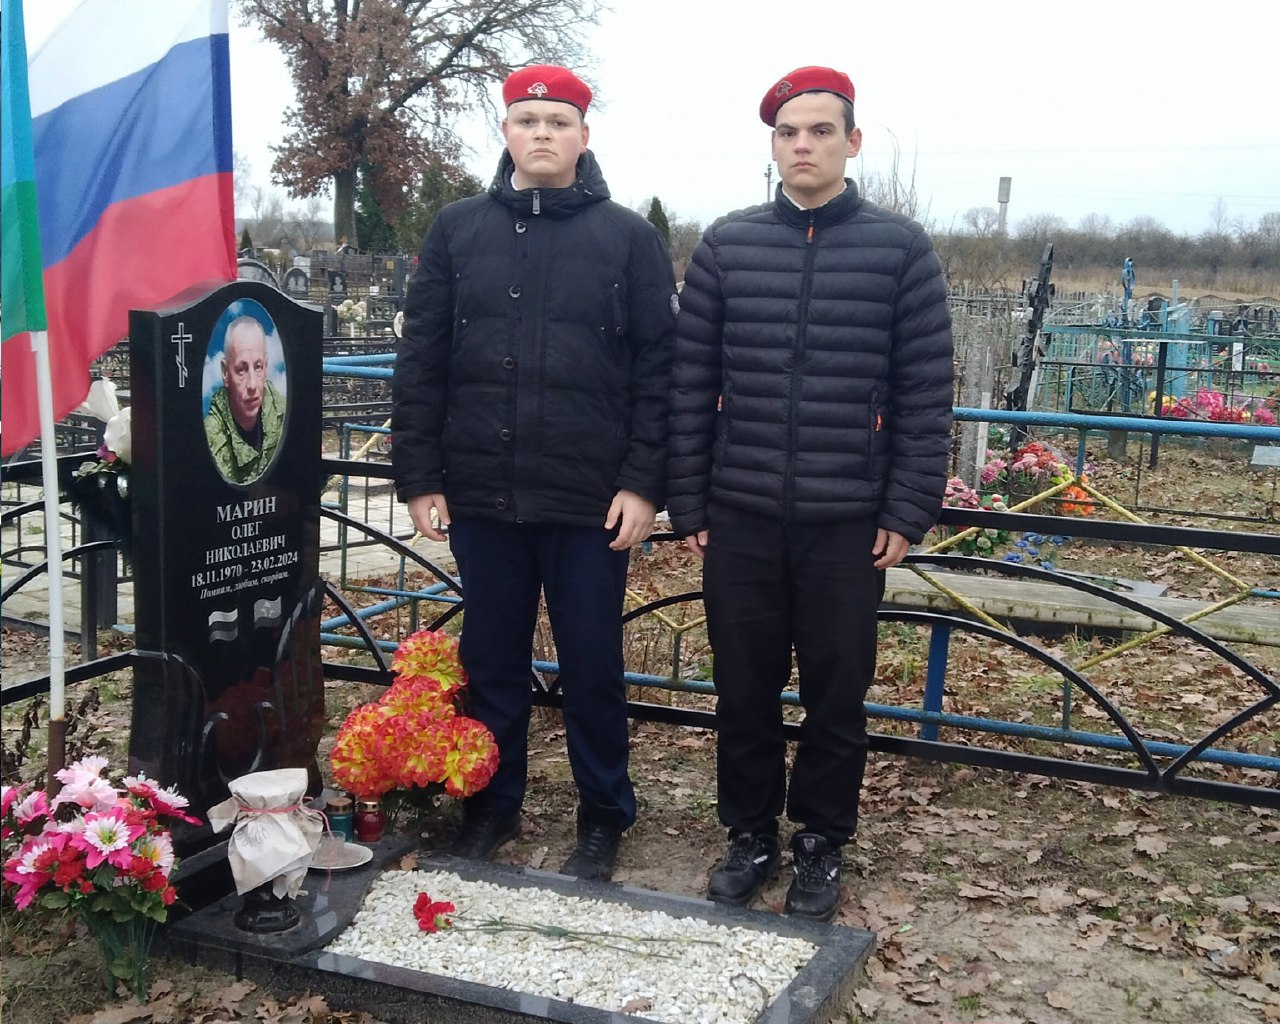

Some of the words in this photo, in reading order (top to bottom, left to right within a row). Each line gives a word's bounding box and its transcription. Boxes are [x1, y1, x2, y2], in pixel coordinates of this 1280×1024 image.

[216, 496, 277, 523] МАРИН
[231, 521, 263, 540] ОЛЕГ
[205, 534, 286, 565] НИКОЛАЕВИЧ
[191, 564, 243, 588] 18.11.1970
[251, 551, 299, 573] 23.02.2024
